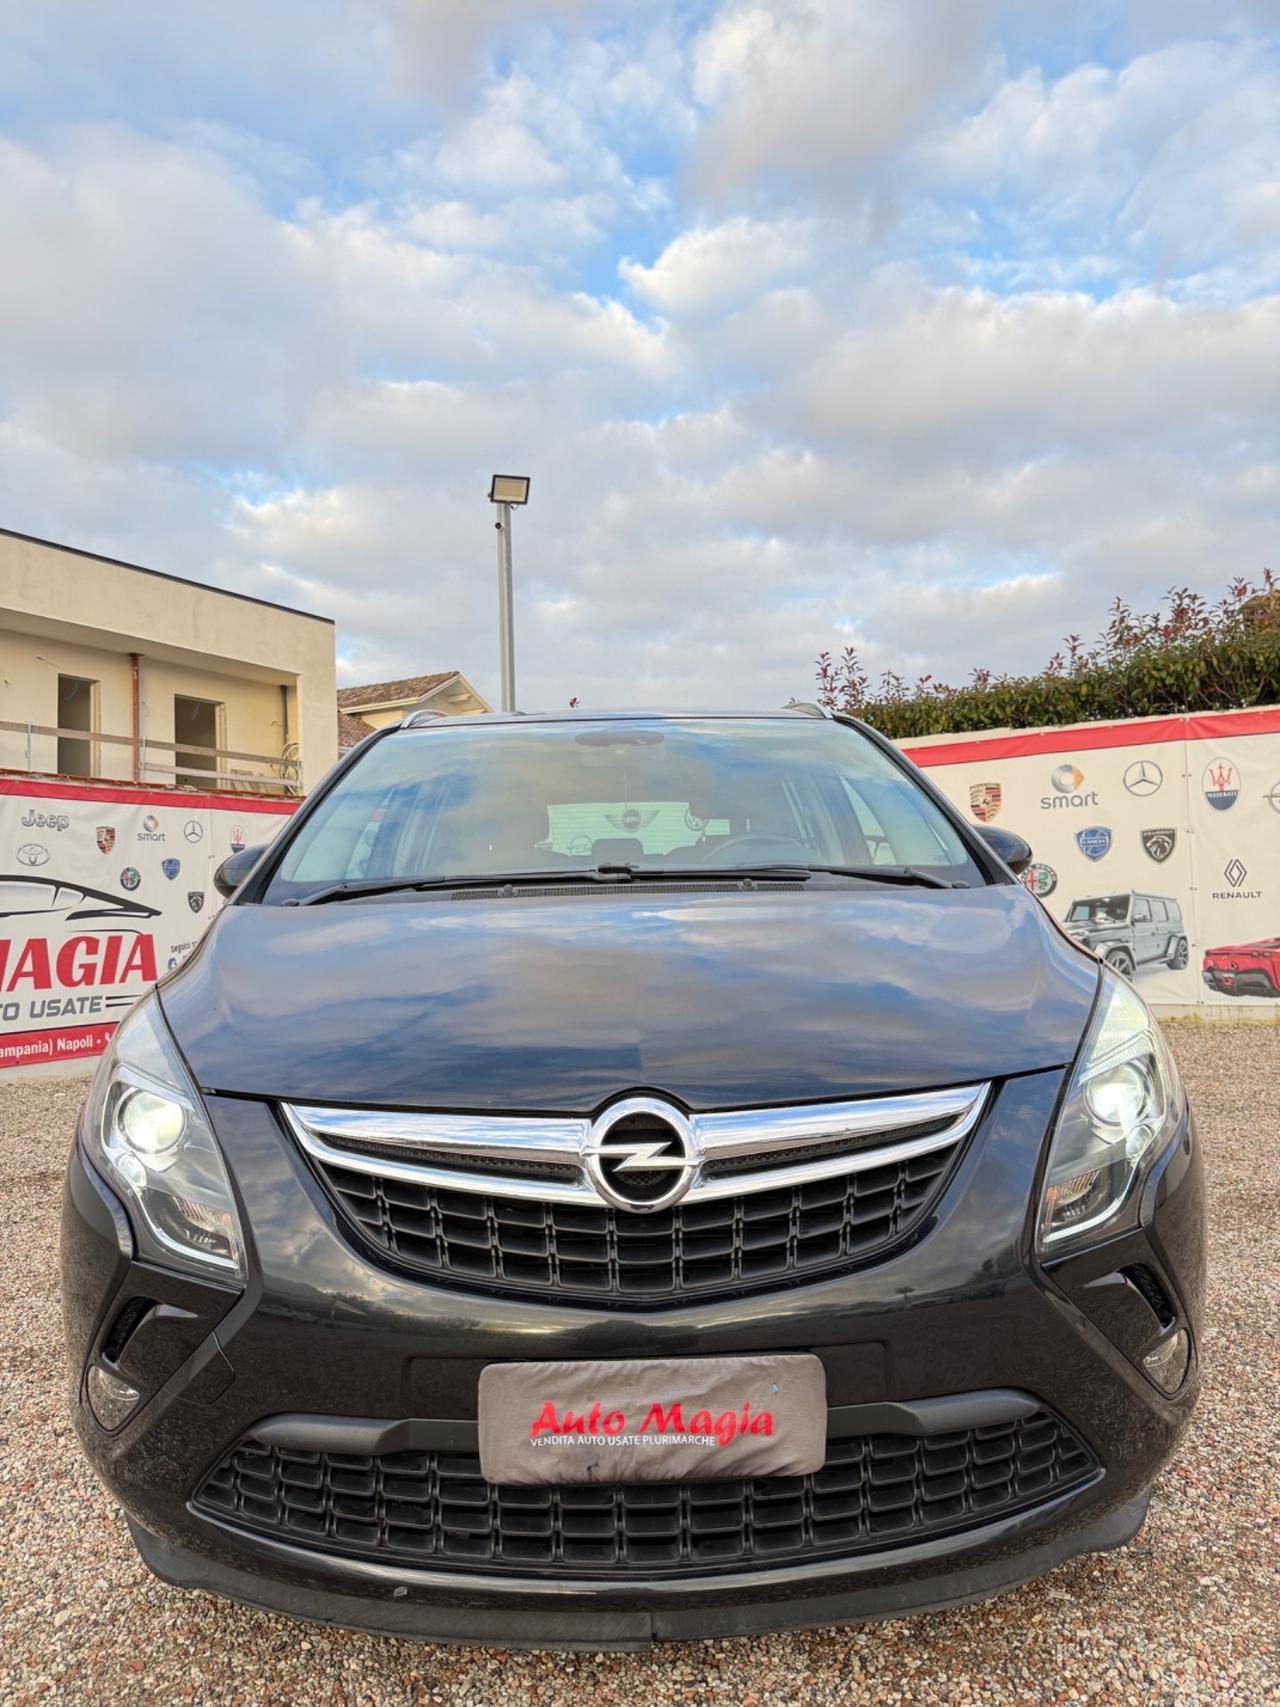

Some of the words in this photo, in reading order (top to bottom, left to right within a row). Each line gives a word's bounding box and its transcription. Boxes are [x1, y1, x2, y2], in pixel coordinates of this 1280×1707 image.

[1040, 791, 1099, 810] smart
[21, 809, 70, 831] Jeep
[137, 832, 166, 842] smart
[1212, 890, 1262, 900] RENAULT
[29, 995, 103, 1019] USATE
[56, 1034, 93, 1052] Napoli
[530, 1401, 626, 1437] Auto
[639, 1401, 774, 1446] Magia
[530, 1434, 575, 1448] VENDITA
[576, 1435, 606, 1446] AUTO
[608, 1435, 640, 1446] USATE
[642, 1434, 715, 1447] PLURIMARCHE
